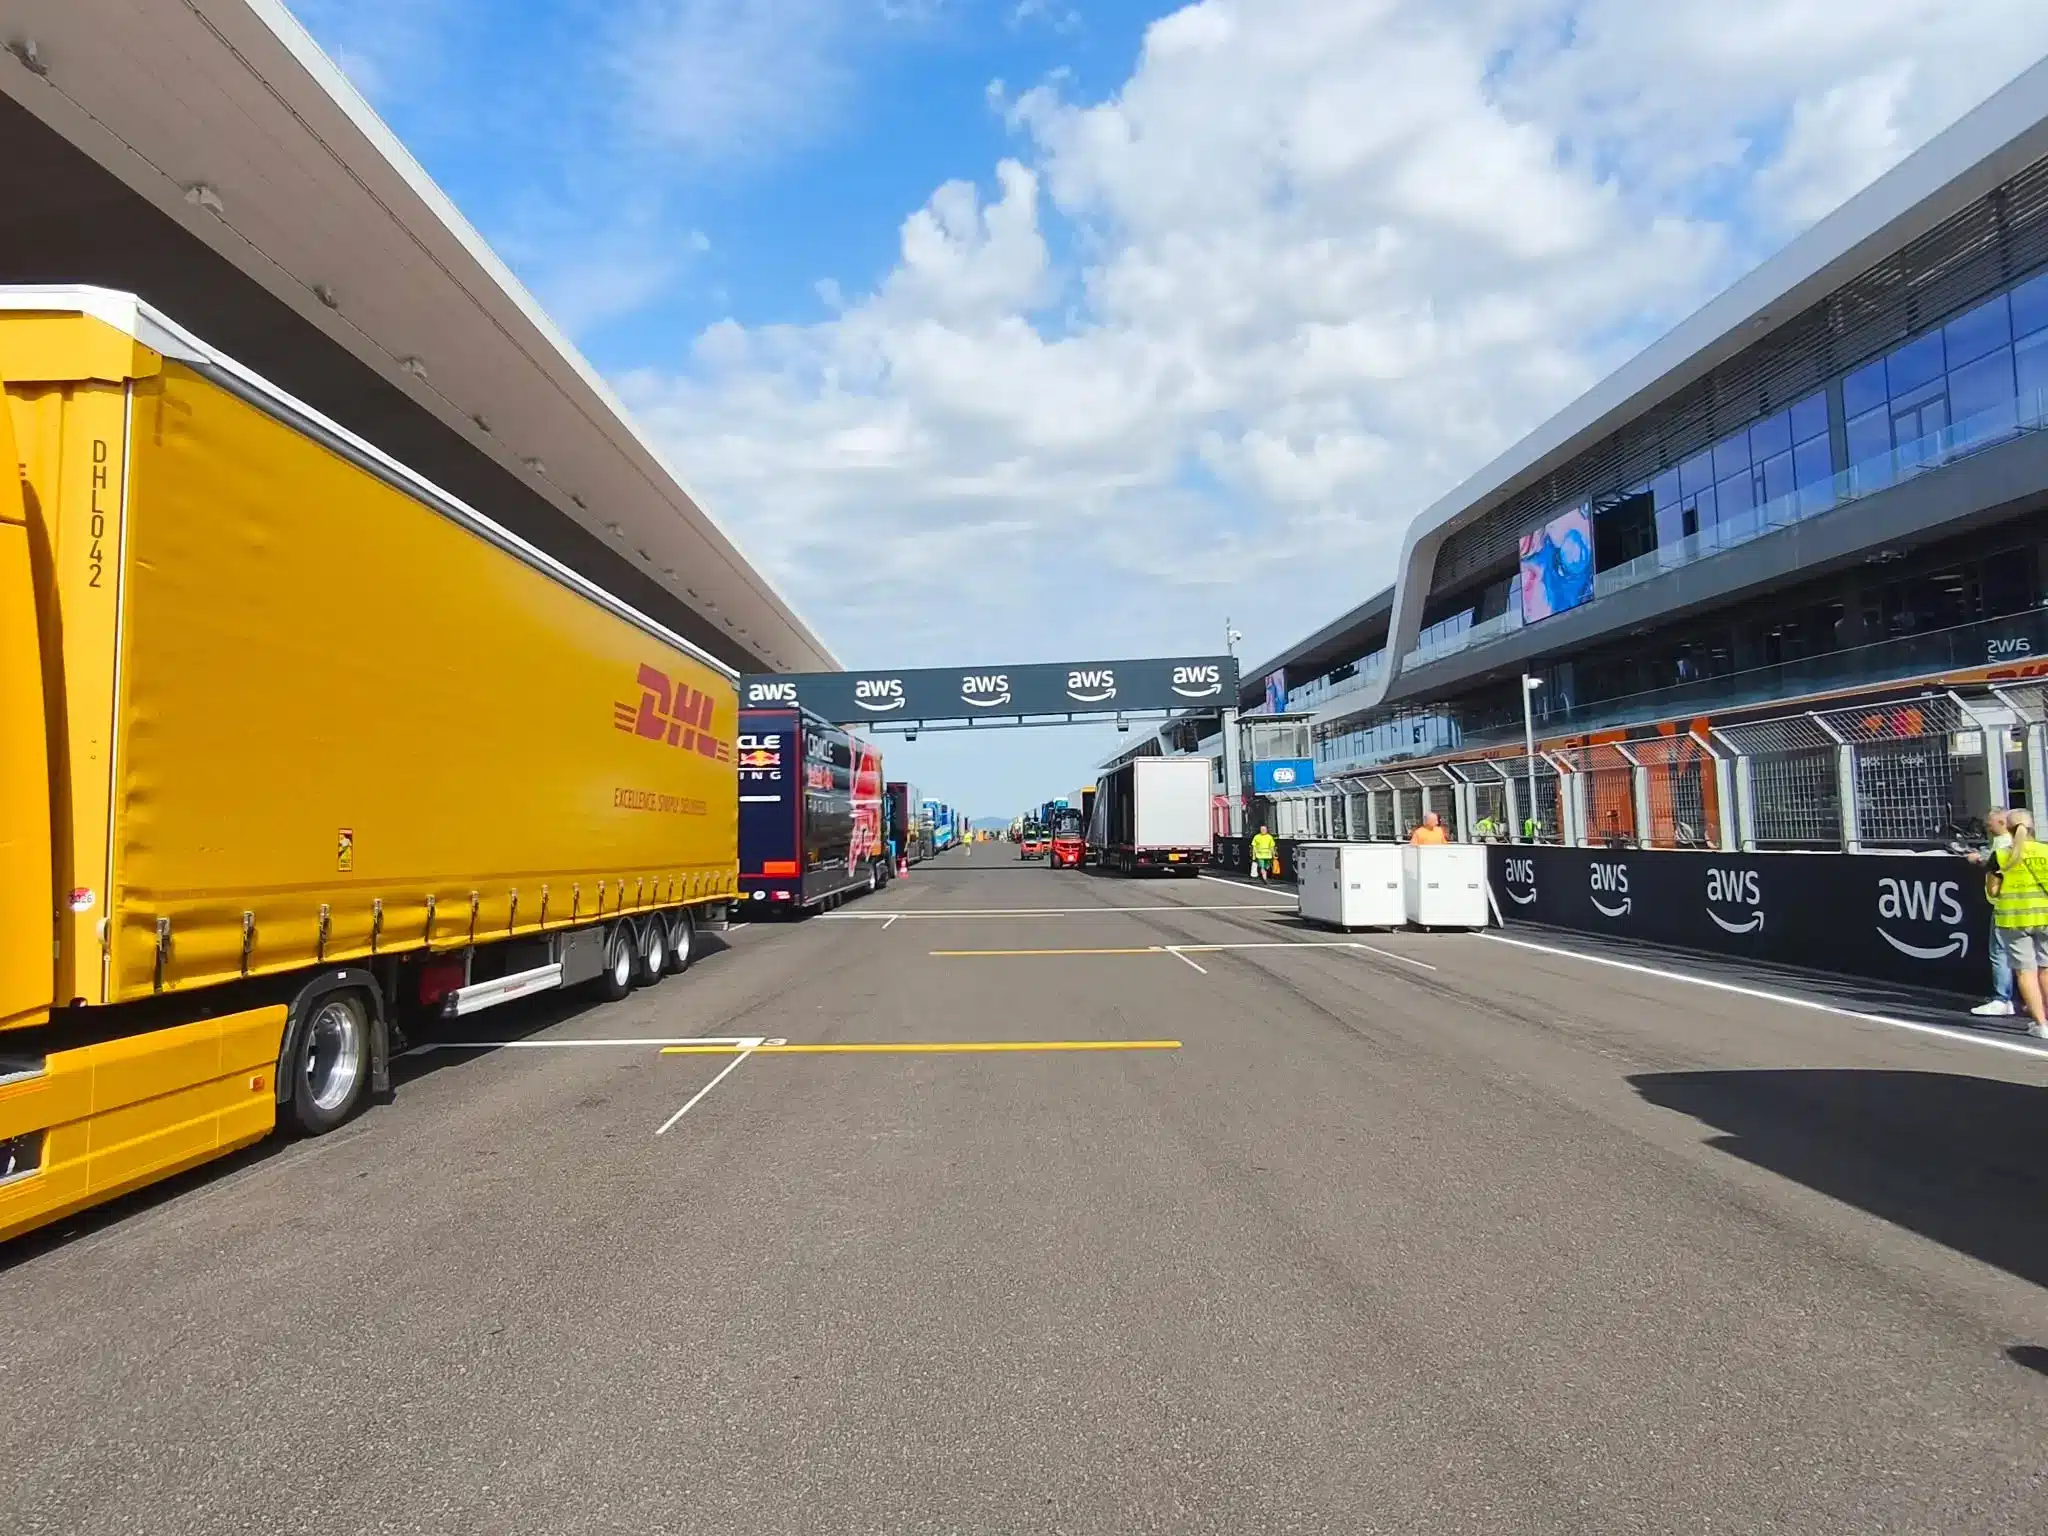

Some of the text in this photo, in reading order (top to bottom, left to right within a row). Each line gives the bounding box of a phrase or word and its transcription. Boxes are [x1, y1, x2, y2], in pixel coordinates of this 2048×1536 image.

[88, 439, 108, 588] DHL042
[855, 679, 904, 697] aws
[962, 675, 1009, 694] aws
[1067, 670, 1114, 688] aws
[1172, 665, 1220, 683] aws
[748, 682, 797, 700] aws
[634, 662, 719, 758] DHL
[807, 733, 834, 763] ORACLE
[1504, 857, 1534, 884] aws
[1590, 862, 1629, 893] aws
[1707, 868, 1761, 906] aws
[1877, 876, 1964, 925] aws
